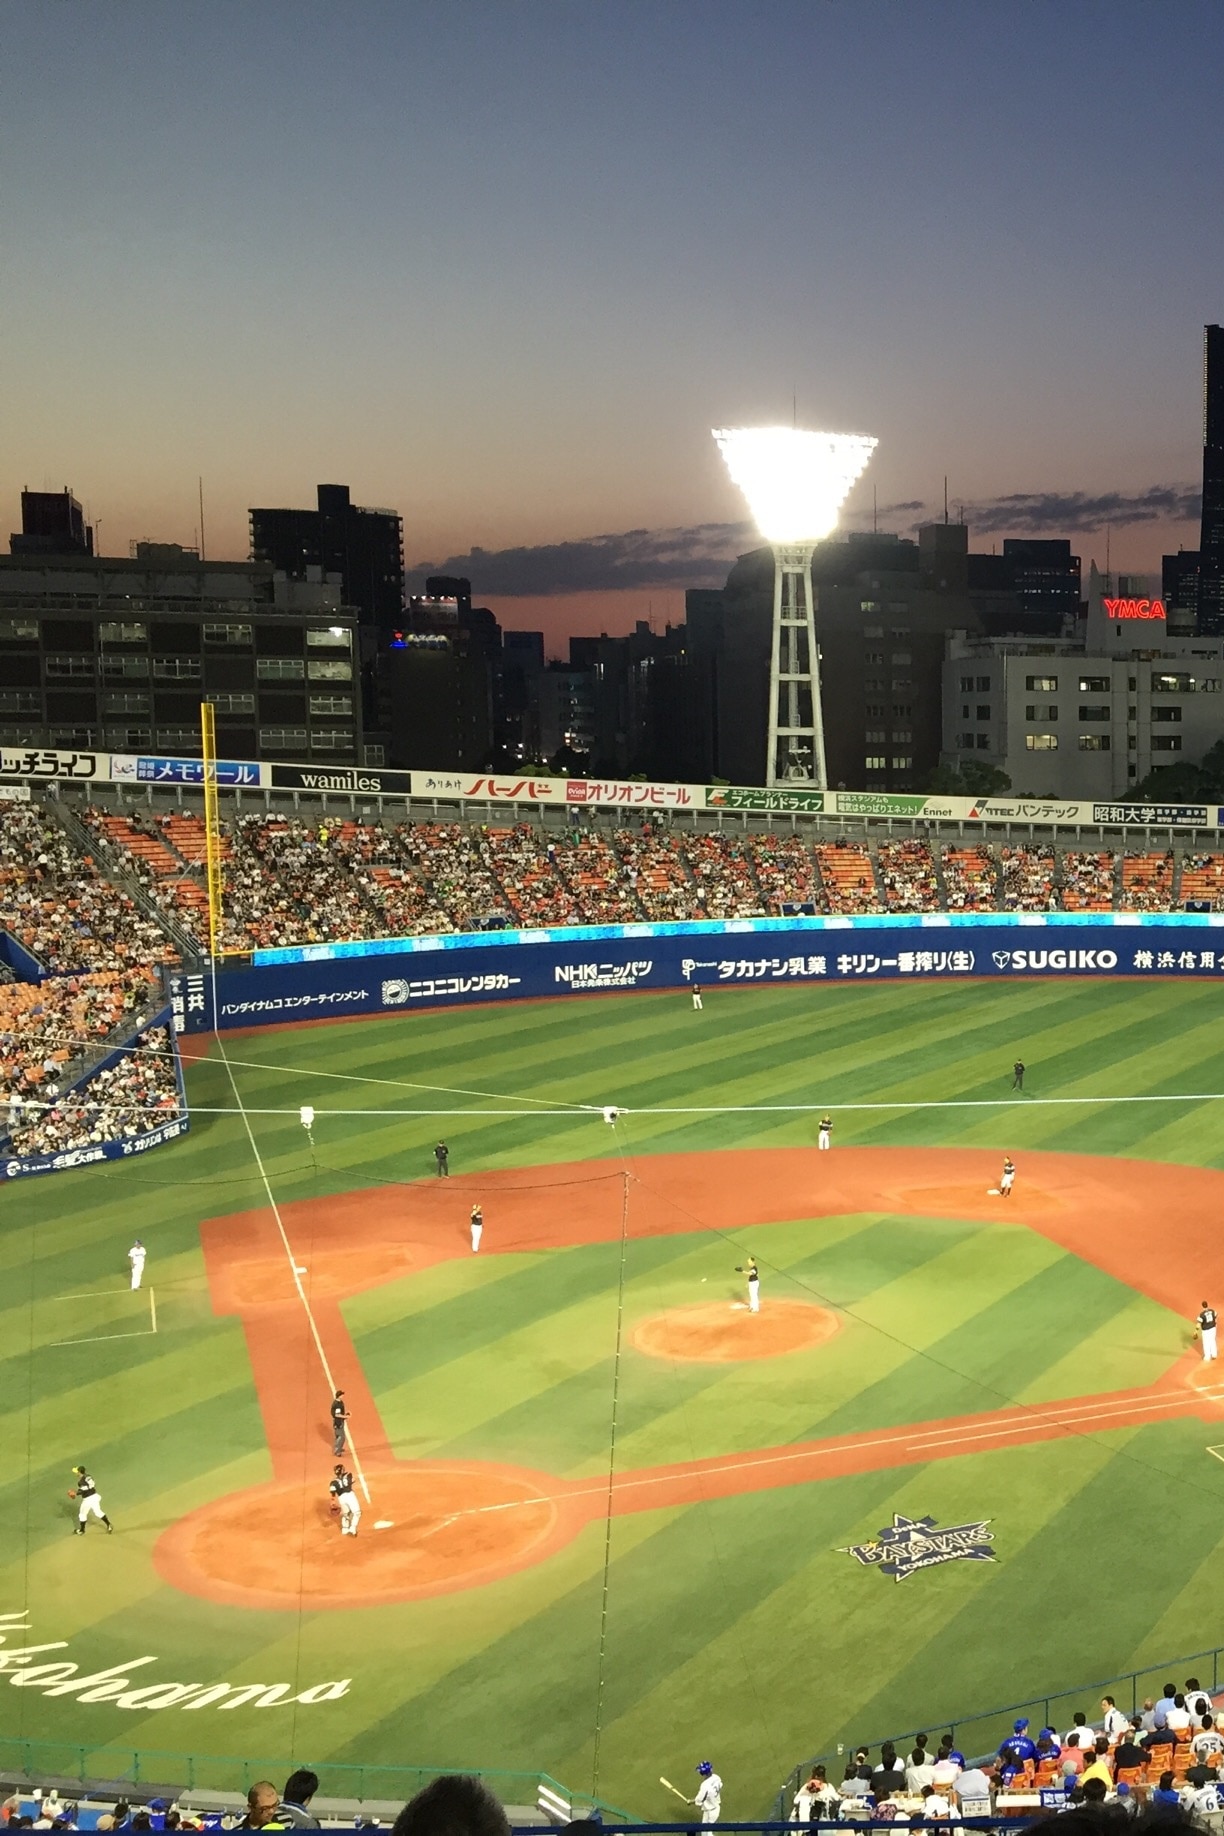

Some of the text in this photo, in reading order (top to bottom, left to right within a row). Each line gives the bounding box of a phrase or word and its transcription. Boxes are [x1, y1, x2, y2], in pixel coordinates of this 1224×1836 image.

[1104, 599, 1166, 619] YMCA
[0, 752, 97, 778] ッチライフ
[300, 770, 381, 791] wamiles
[425, 778, 462, 791] ありあけ
[587, 784, 691, 805] オリオンビール
[731, 796, 823, 811] フィールドライフ
[923, 807, 953, 817] Ennet
[1015, 804, 1080, 819] バンテック
[1094, 807, 1156, 823] 昭和大学
[718, 956, 827, 978] タカナシ乳業
[1012, 950, 1118, 970] SUGIKO
[408, 973, 521, 998] ニコニコレンタカー
[892, 1522, 928, 1535] DeNA
[849, 1527, 995, 1566] BAYSTARS
[897, 1548, 976, 1572] YOKOHAMA
[1205, 1797, 1214, 1811] 6
